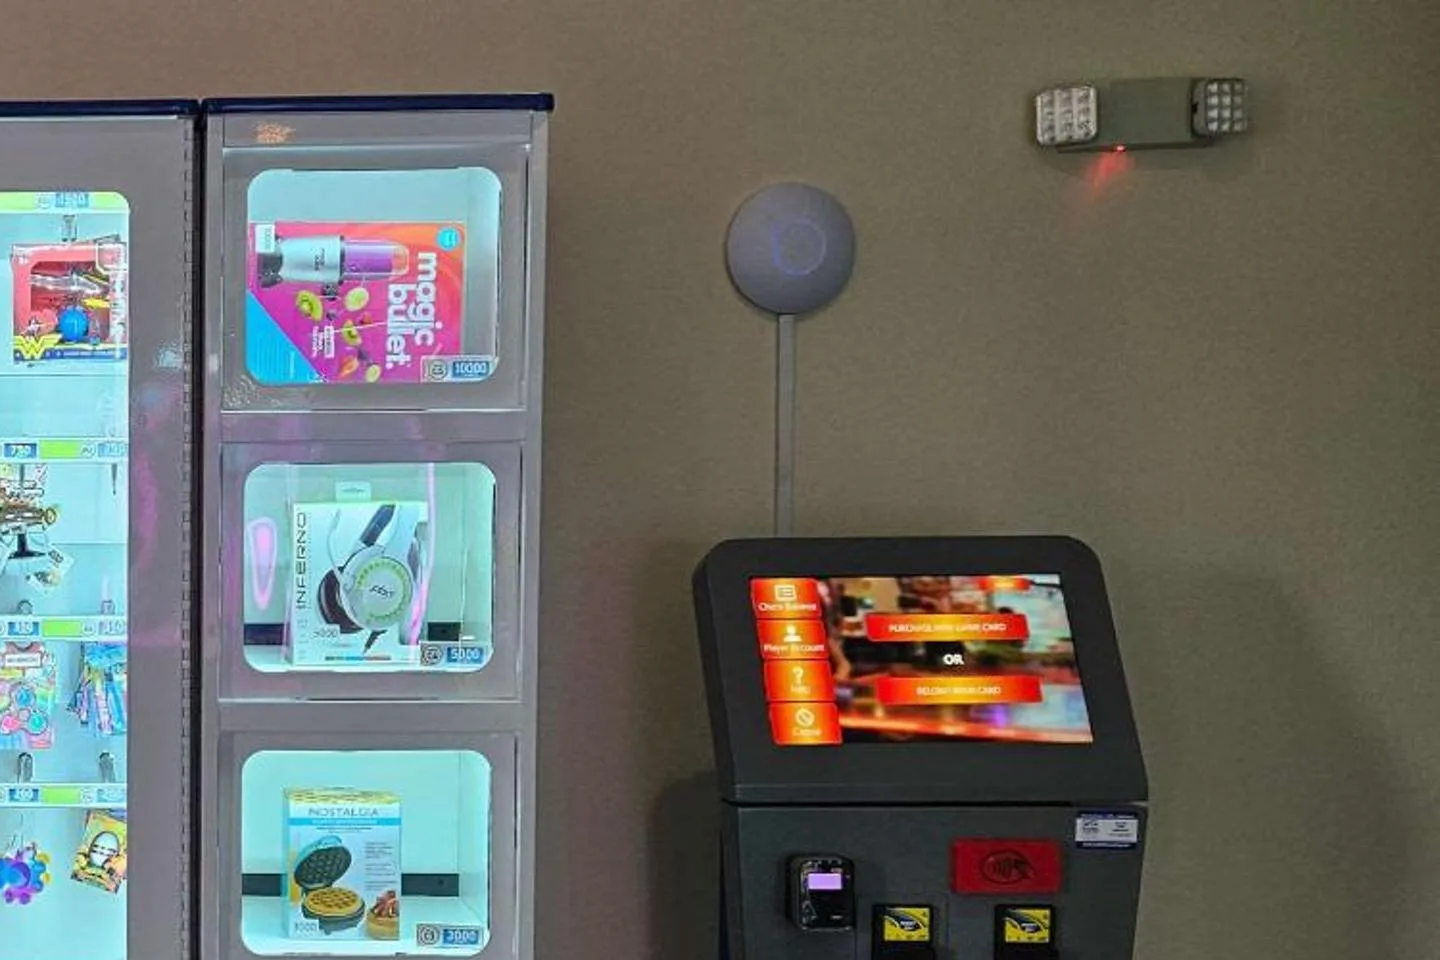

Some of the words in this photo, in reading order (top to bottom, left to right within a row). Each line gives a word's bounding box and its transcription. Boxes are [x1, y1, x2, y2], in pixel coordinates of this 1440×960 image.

[409, 251, 443, 346] magic
[296, 511, 307, 609] INFERNO
[943, 653, 965, 666] OR
